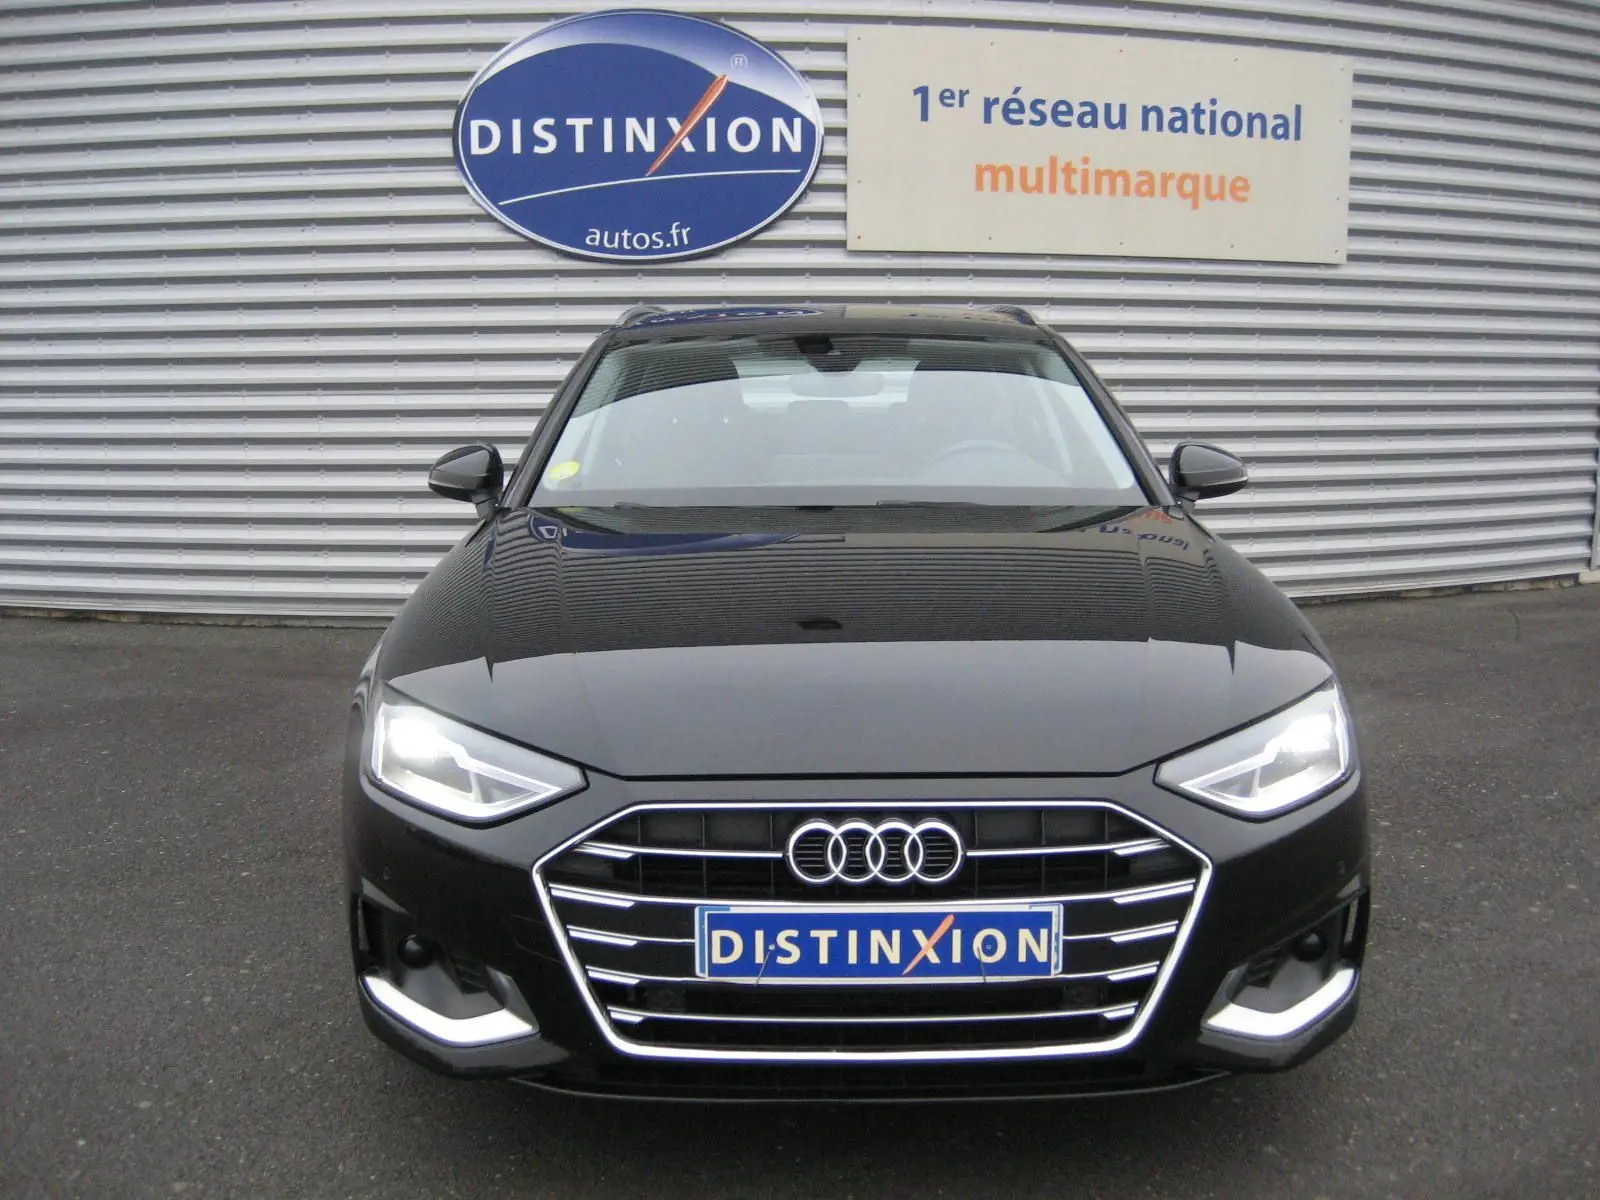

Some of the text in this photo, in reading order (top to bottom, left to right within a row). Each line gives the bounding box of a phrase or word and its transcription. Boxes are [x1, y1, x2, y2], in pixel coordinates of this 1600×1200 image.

[912, 85, 1302, 141] 1er réseau national
[469, 117, 802, 155] DISTINXION
[974, 155, 1251, 210] multimarque
[585, 222, 691, 250] autos.fr
[711, 929, 1049, 965] DISTINXION
